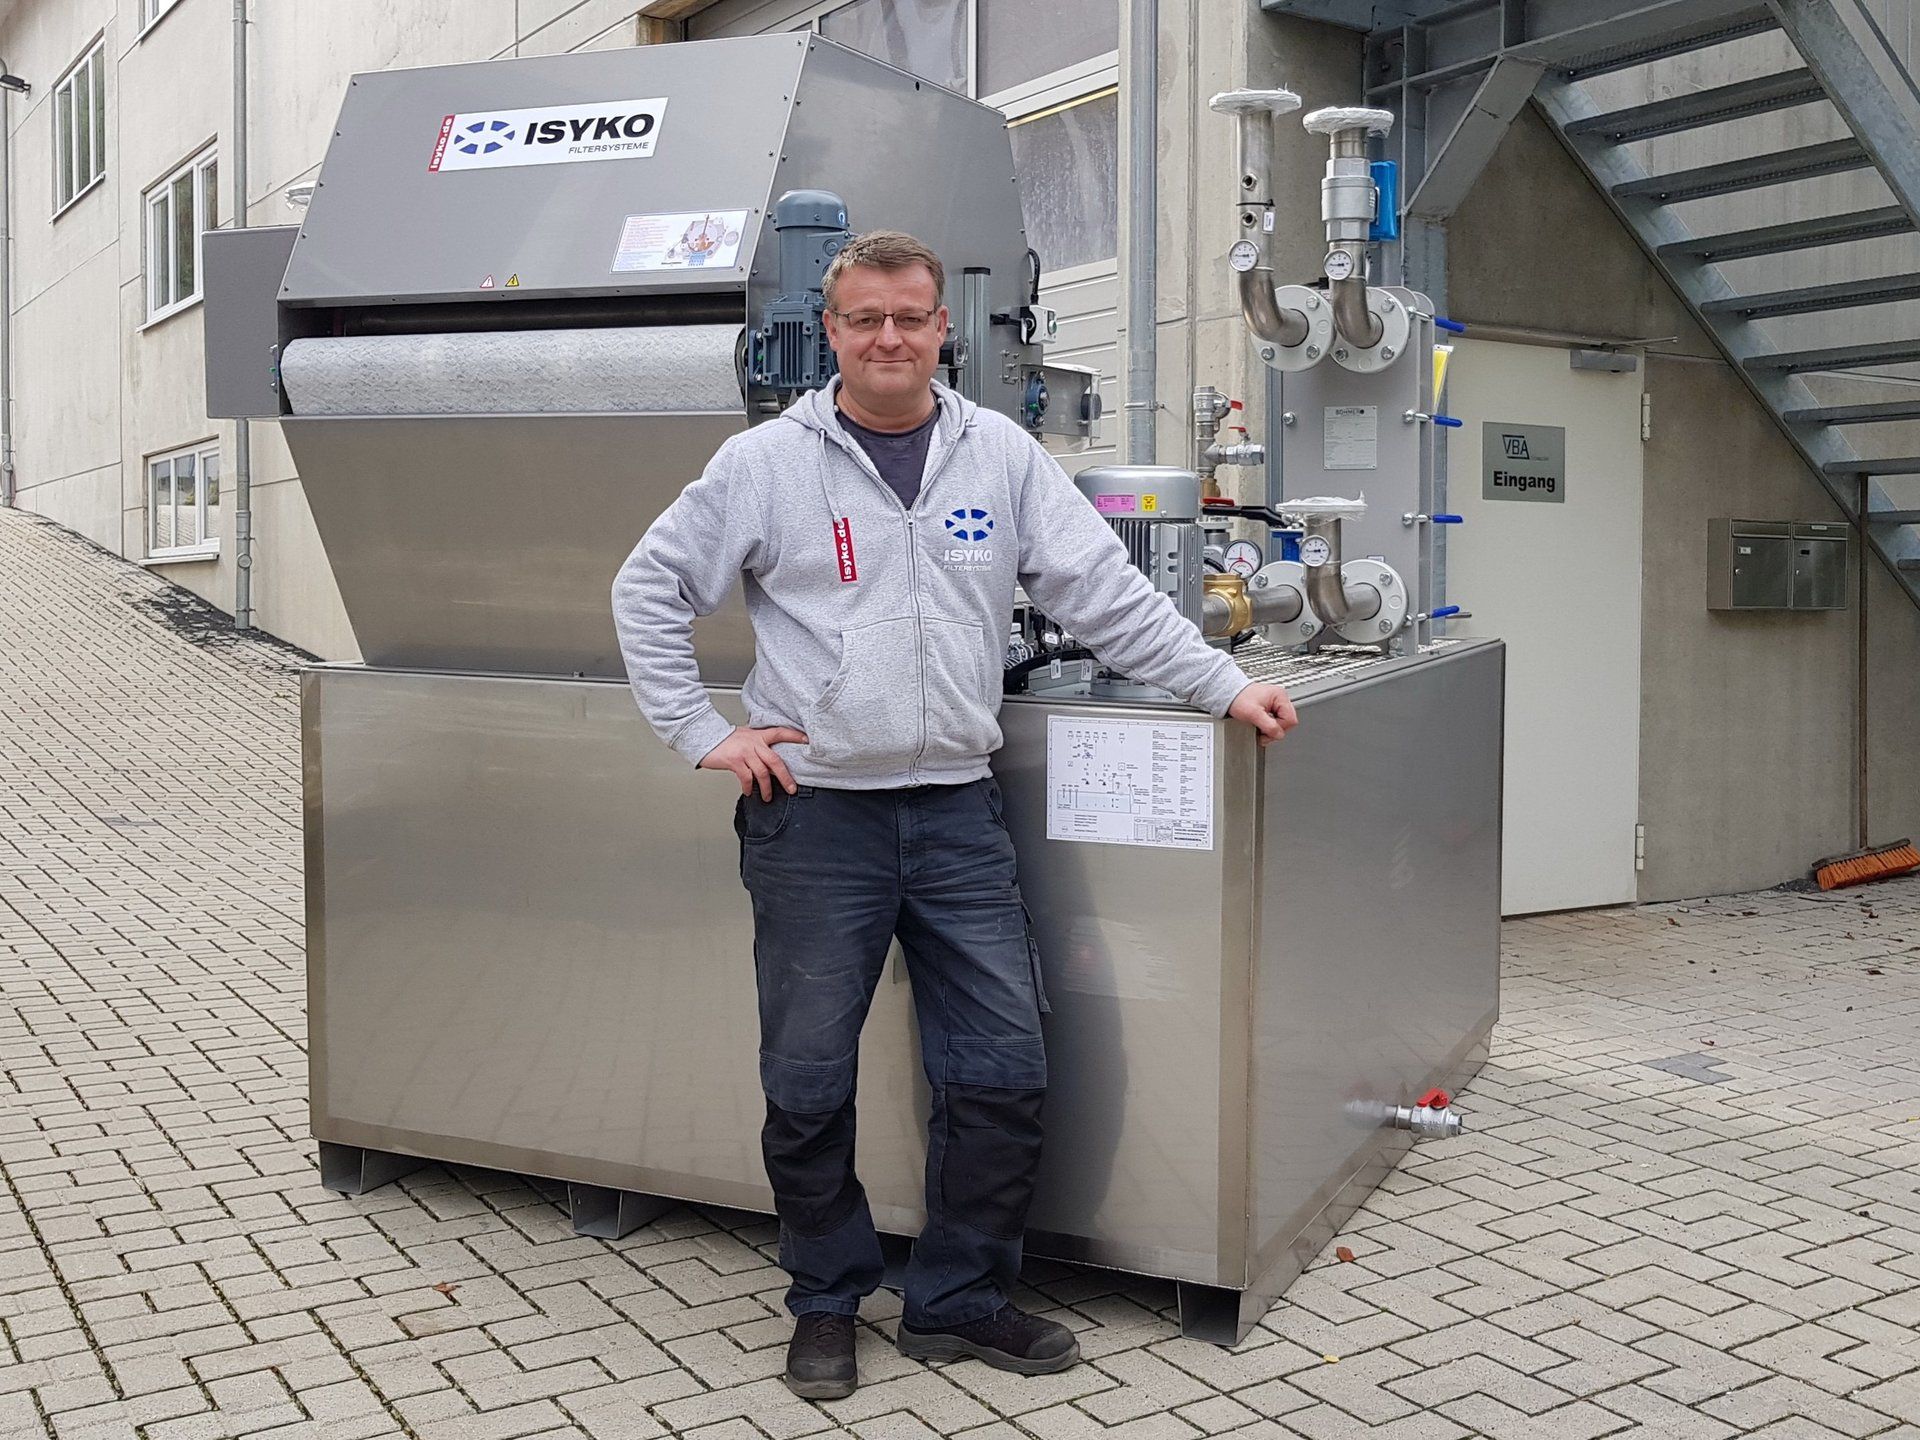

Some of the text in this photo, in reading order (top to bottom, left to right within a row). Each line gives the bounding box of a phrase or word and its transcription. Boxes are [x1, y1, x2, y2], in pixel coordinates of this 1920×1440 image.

[523, 113, 655, 145] ISYKO
[568, 141, 650, 155] FILTERSYSTEME
[1502, 434, 1530, 460] VBA
[1493, 470, 1556, 493] Eingang
[943, 549, 993, 562] ISYKO
